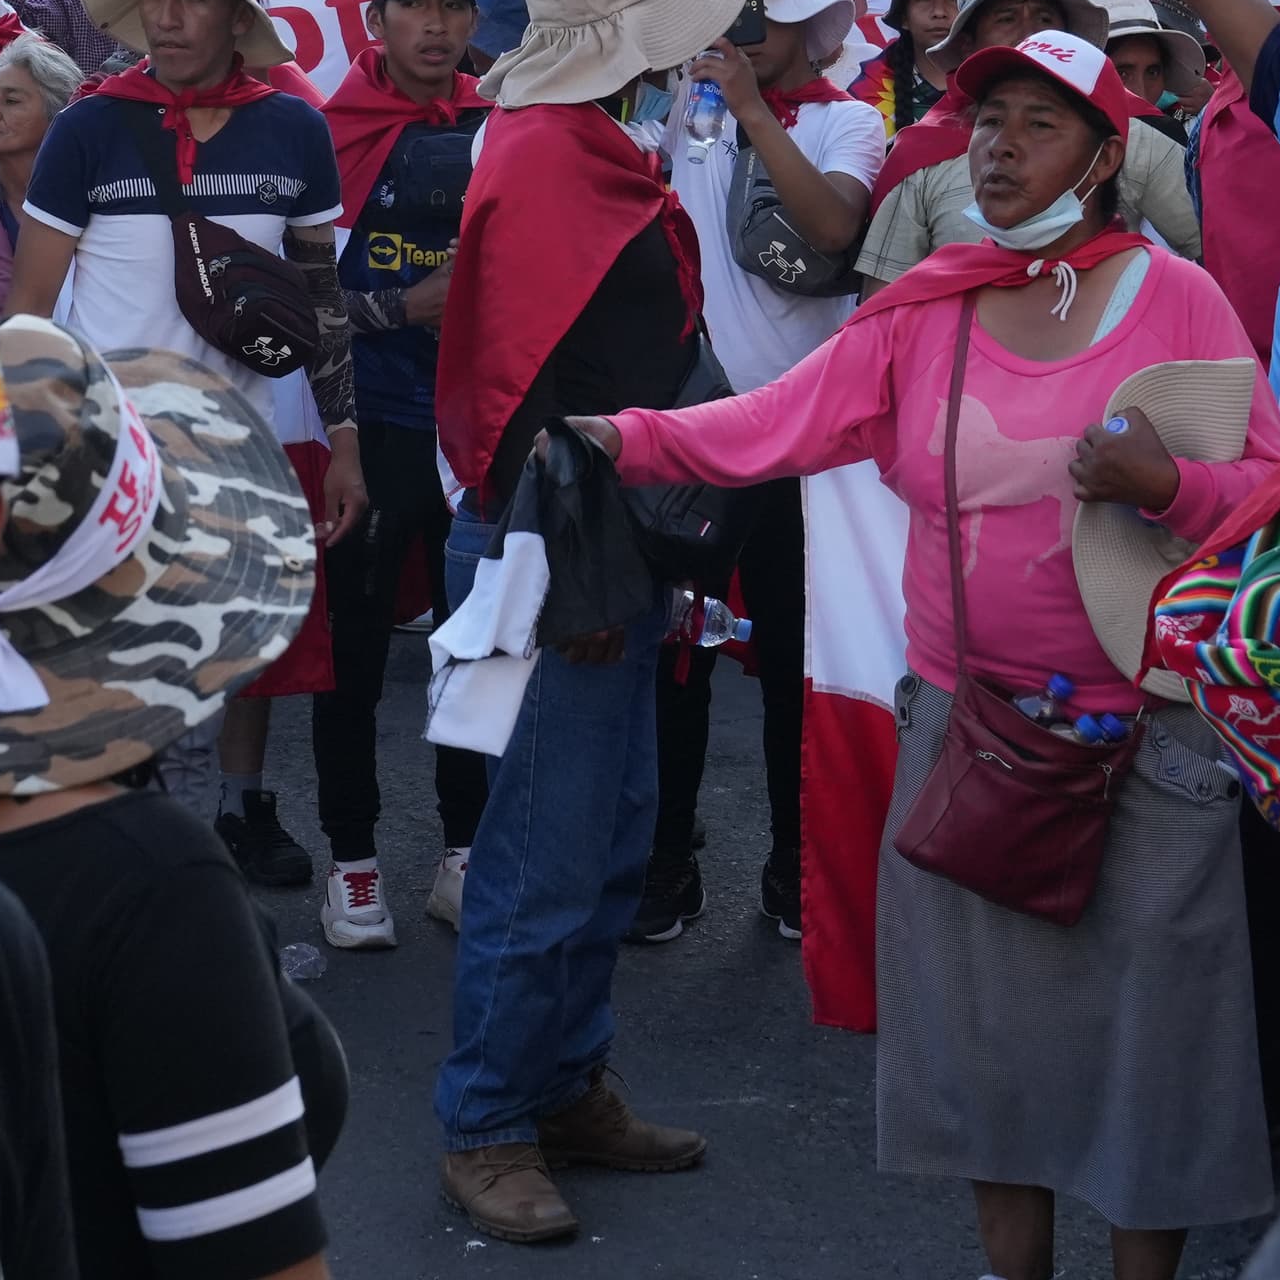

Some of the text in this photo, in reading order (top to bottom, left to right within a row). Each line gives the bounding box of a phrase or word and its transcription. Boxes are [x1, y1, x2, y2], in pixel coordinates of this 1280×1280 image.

[1016, 38, 1077, 63] erú
[188, 222, 213, 297] UNDER ARMOUR
